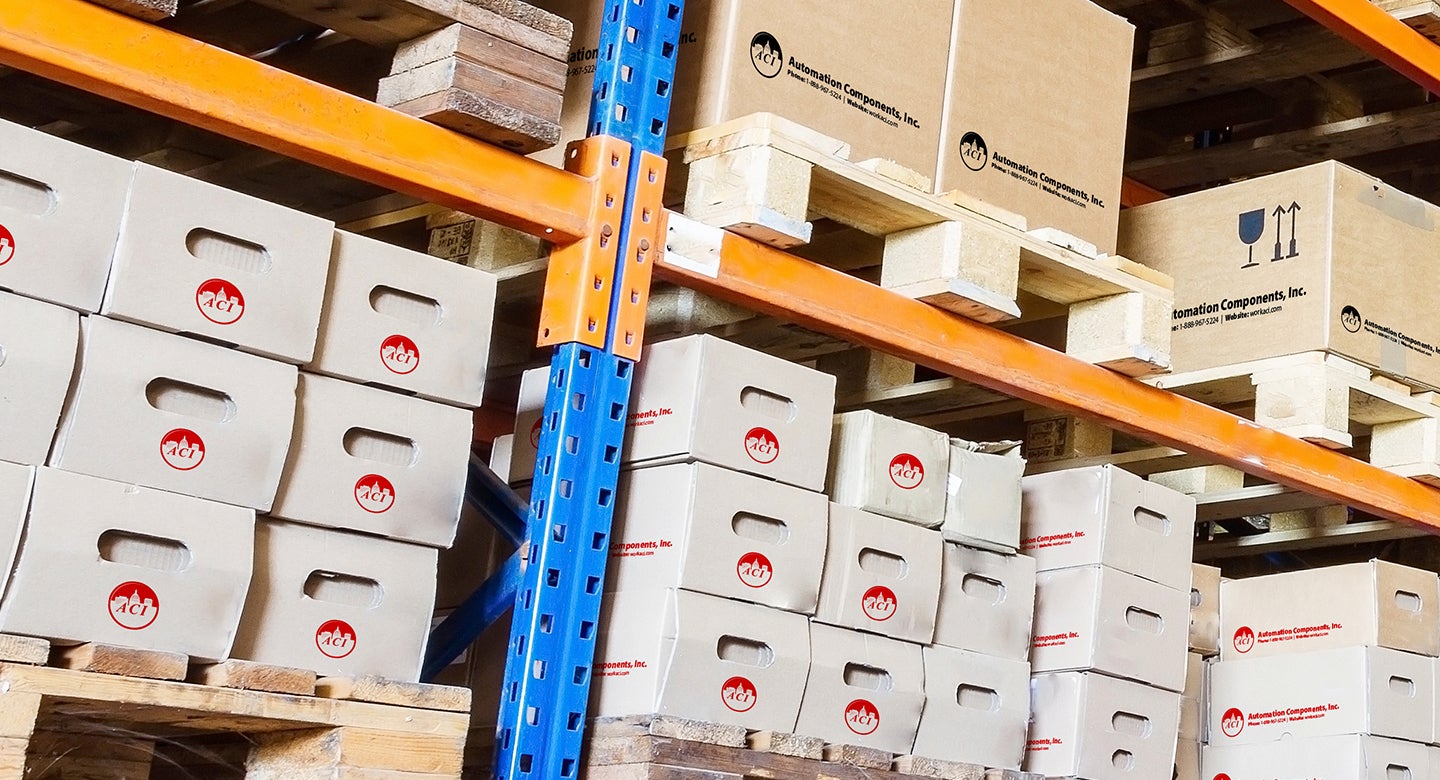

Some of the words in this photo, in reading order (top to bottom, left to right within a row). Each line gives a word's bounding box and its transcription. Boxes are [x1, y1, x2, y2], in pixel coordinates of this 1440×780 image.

[679, 32, 697, 44] nc.
[567, 47, 598, 63] ation
[754, 51, 776, 67] ACI
[787, 69, 806, 83] Phone:
[846, 98, 868, 114] Website:
[868, 110, 899, 128] workaci.com
[788, 56, 842, 91] Automation
[843, 83, 902, 121] Components,
[903, 112, 920, 129] Inc.
[964, 149, 982, 161] ACI
[992, 152, 1038, 179] Automation
[1040, 172, 1090, 202] Components,
[1091, 194, 1105, 208] Inc.
[203, 297, 236, 315] ACI
[1172, 302, 1219, 320] tomation
[1220, 290, 1286, 310] Components,
[1288, 286, 1307, 298] Inc.
[1179, 316, 1219, 330] 1-888-967-5224
[1225, 312, 1250, 322] Website:
[1249, 306, 1283, 317] workaci.com
[1344, 316, 1357, 326] ACI
[1364, 319, 1398, 338] Automation
[1398, 332, 1435, 353] Components,
[386, 350, 412, 364] ACI
[630, 410, 658, 420] onents,
[659, 407, 673, 416] Inc.
[167, 446, 196, 460] ACI
[749, 443, 772, 455] ACI
[895, 468, 917, 480] ACI
[360, 490, 387, 503] ACI
[610, 541, 659, 551] Components,
[660, 539, 673, 548] Inc.
[742, 567, 766, 579] ACI
[116, 600, 148, 618] ACI
[867, 600, 891, 612] ACI
[1257, 628, 1293, 639] Automation
[1292, 623, 1331, 634] Components,
[1331, 622, 1343, 630] Inc.
[321, 634, 349, 648] ACI
[1236, 636, 1250, 646] ACI
[593, 661, 634, 671] omponents,
[634, 660, 648, 668] Inc.
[726, 691, 750, 703] ACI
[1248, 709, 1286, 720] Automation
[1285, 704, 1327, 716] Components,
[1328, 703, 1340, 711] Inc.
[849, 714, 872, 726] ACI
[1225, 719, 1240, 729] ACI
